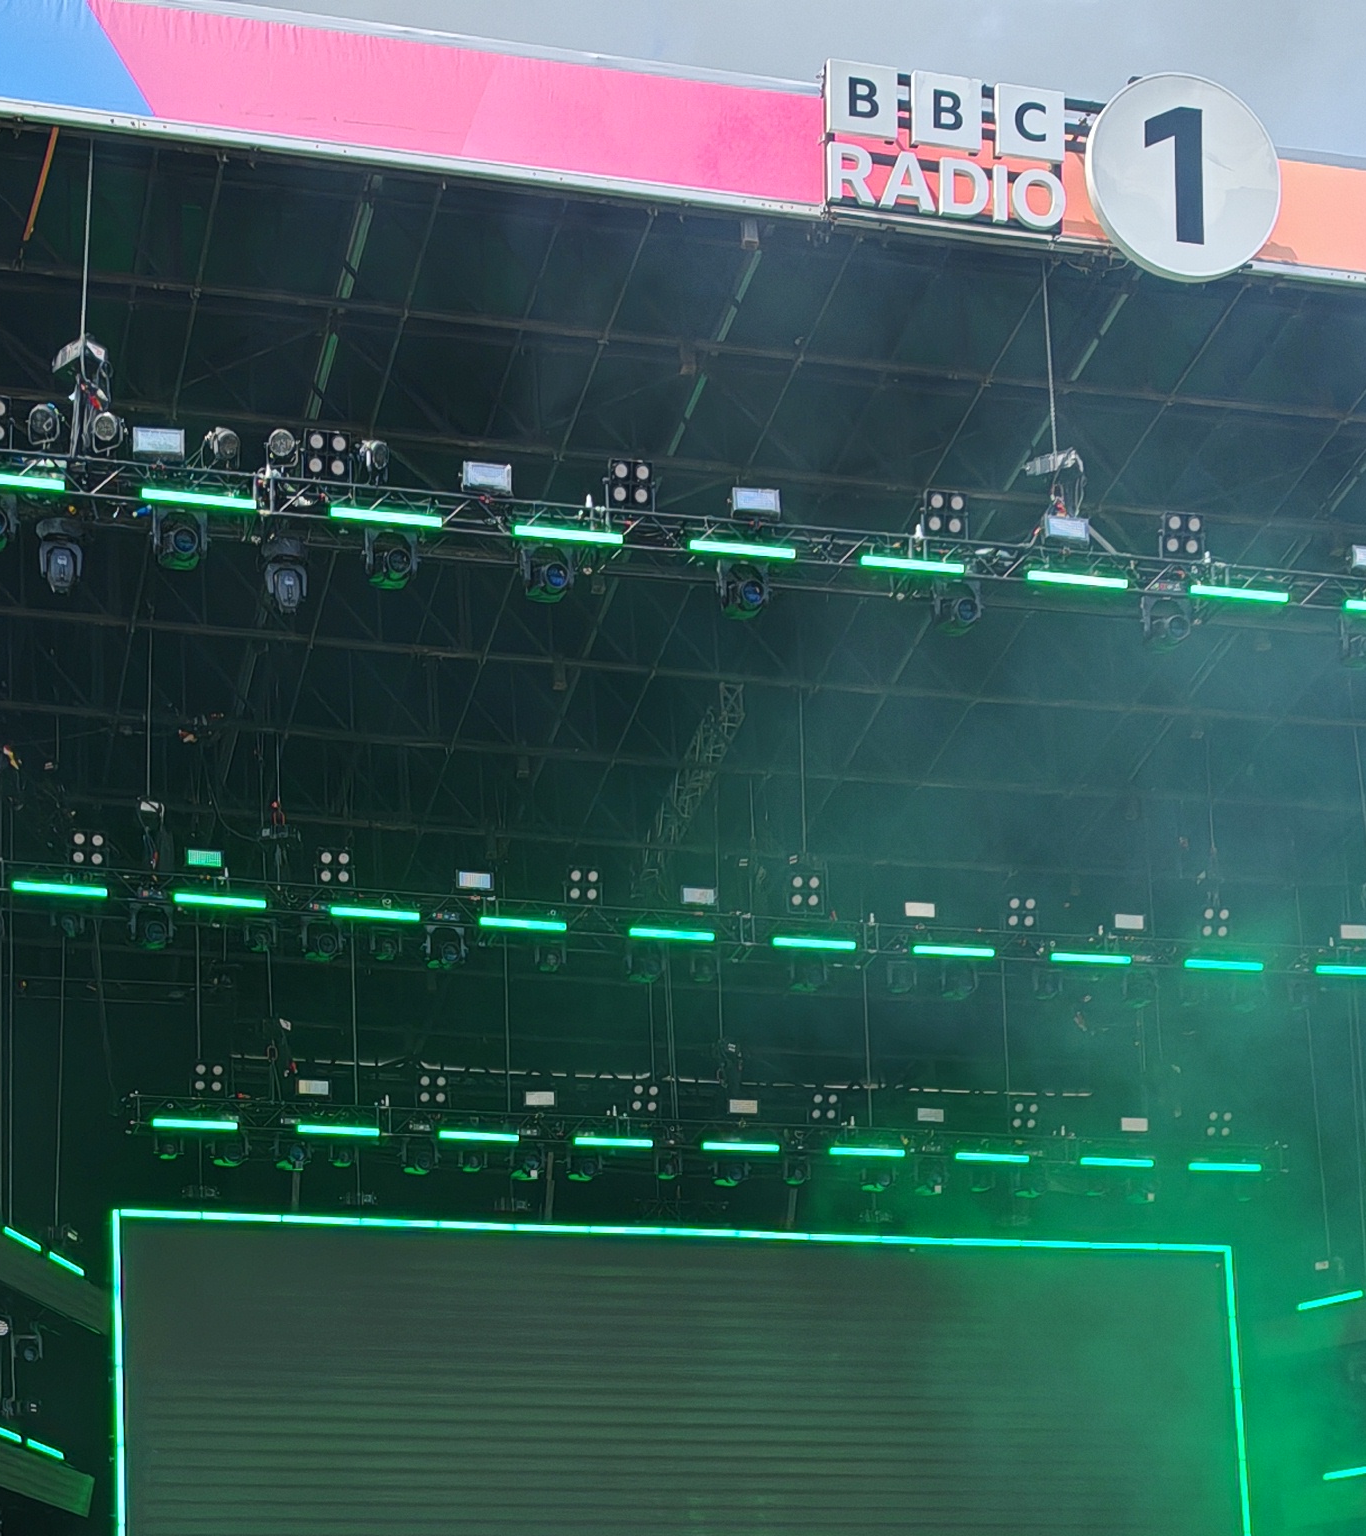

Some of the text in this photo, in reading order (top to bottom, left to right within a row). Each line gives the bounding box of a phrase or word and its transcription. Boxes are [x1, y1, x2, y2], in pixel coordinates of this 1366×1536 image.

[847, 76, 1048, 143] BBC
[826, 140, 1066, 231] RADIO
[1144, 106, 1206, 246] 1
